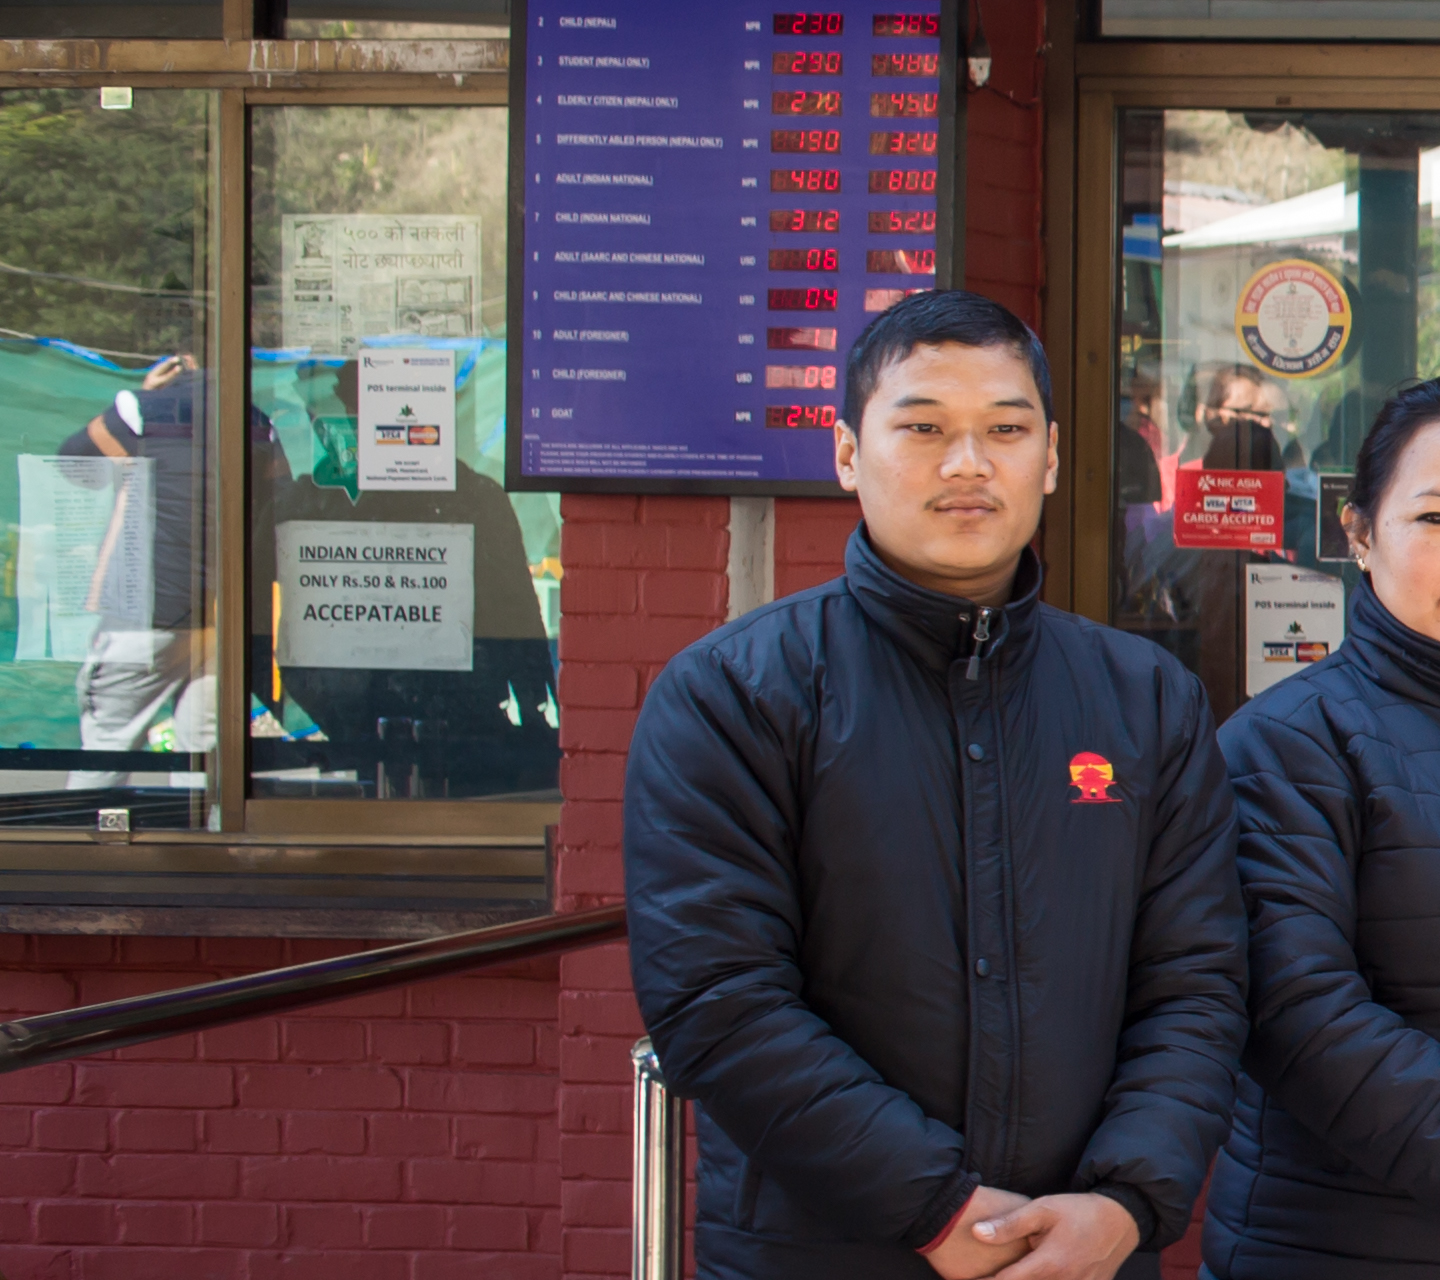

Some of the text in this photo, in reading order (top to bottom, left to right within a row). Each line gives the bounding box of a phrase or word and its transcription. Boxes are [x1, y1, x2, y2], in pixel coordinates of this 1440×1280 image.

[744, 21, 761, 31] NPR
[792, 13, 841, 33] 230
[892, 13, 938, 33] 385
[743, 60, 760, 70] NPR
[791, 53, 840, 72] 290
[743, 99, 759, 109] NPR
[742, 138, 759, 148] NPR
[799, 131, 839, 151] 190
[741, 177, 757, 187] NPR
[889, 171, 936, 190] 800
[740, 216, 756, 226] NPR
[790, 210, 838, 230] 312
[384, 220, 405, 241] को
[739, 255, 756, 266] USD
[739, 294, 755, 305] USD
[805, 289, 837, 309] 04
[737, 333, 754, 344] USD
[735, 372, 753, 383] USD
[367, 384, 447, 393] POS terminal inside
[735, 411, 751, 422] NPR
[787, 406, 836, 427] 240
[1217, 477, 1262, 489] NIC ASIA
[1183, 513, 1275, 526] CARDS ACCEPTED
[299, 546, 448, 562] INDIAN CURRENCY
[299, 574, 447, 589] ONLY Rs.50 & Rs.100
[303, 604, 442, 623] ACCEPATABLE
[1255, 601, 1335, 610] POS terminal inside
